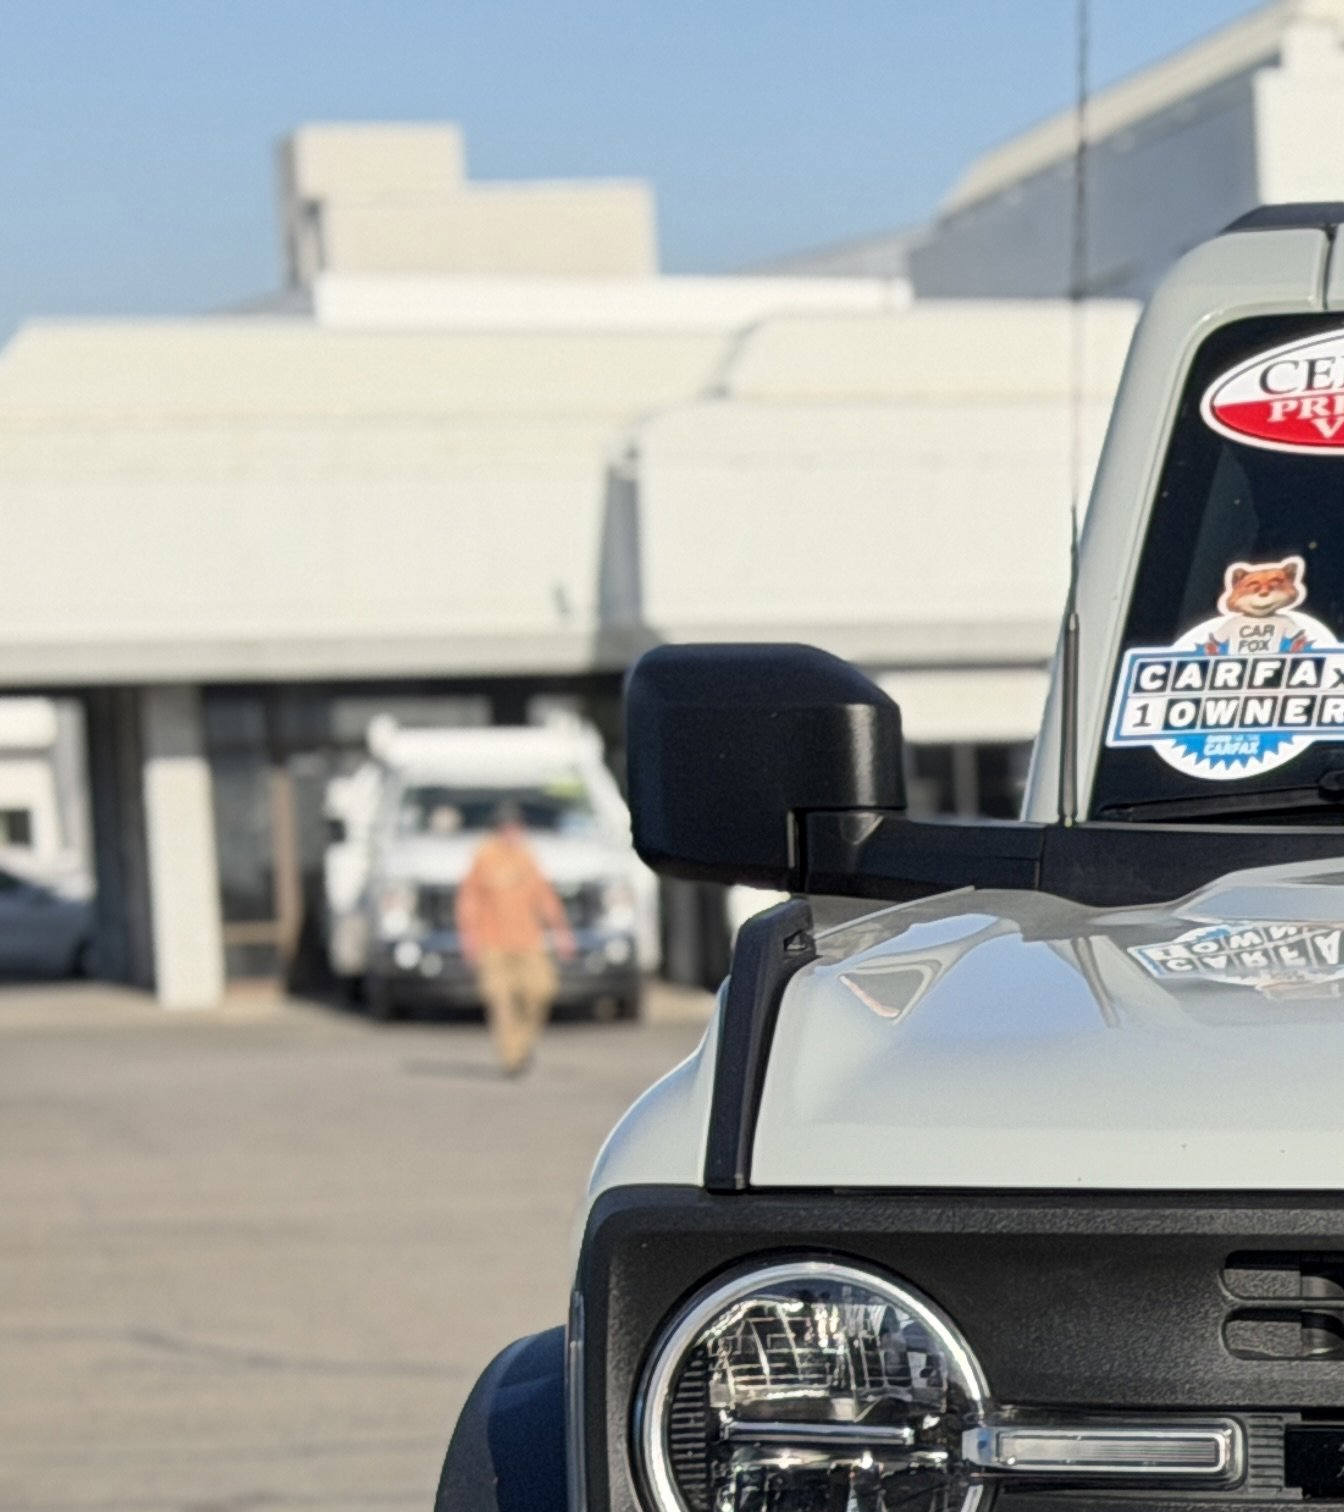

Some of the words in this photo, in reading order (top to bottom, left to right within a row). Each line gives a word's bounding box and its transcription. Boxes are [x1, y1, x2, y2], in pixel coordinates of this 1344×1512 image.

[1239, 624, 1276, 639] CAR
[1238, 639, 1271, 652] FOX
[1132, 702, 1153, 728] 1
